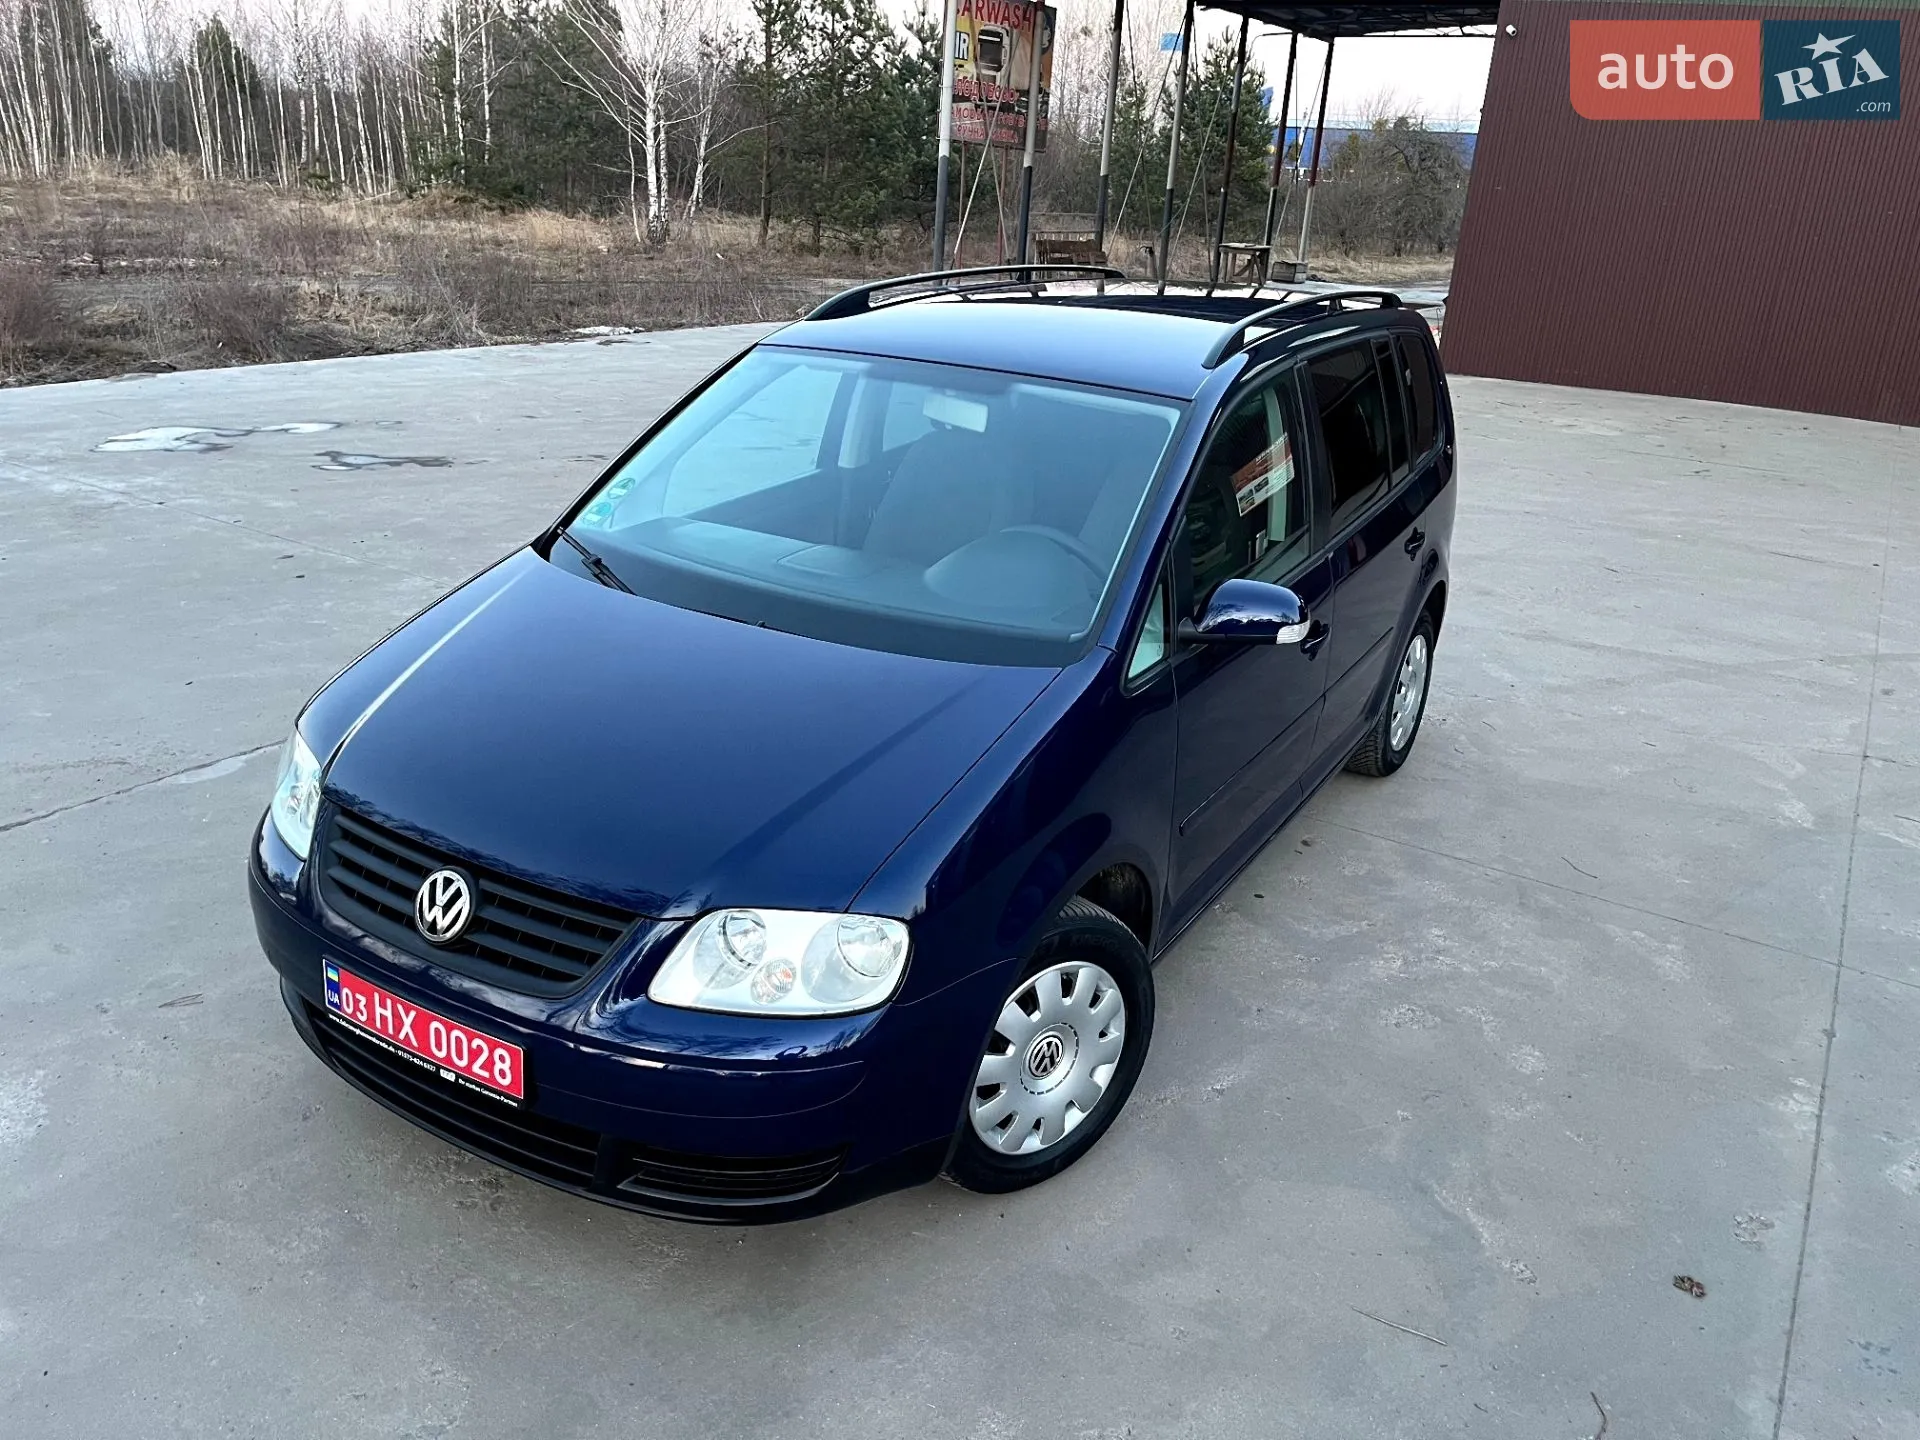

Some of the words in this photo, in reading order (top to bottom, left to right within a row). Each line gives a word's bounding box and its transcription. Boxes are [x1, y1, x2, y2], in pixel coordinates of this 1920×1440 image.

[957, 0, 1032, 32] ARWASH
[416, 870, 470, 942] VW
[328, 989, 340, 1005] UA
[342, 987, 368, 1022] 03
[374, 992, 419, 1047] HX
[429, 1021, 512, 1086] 0028
